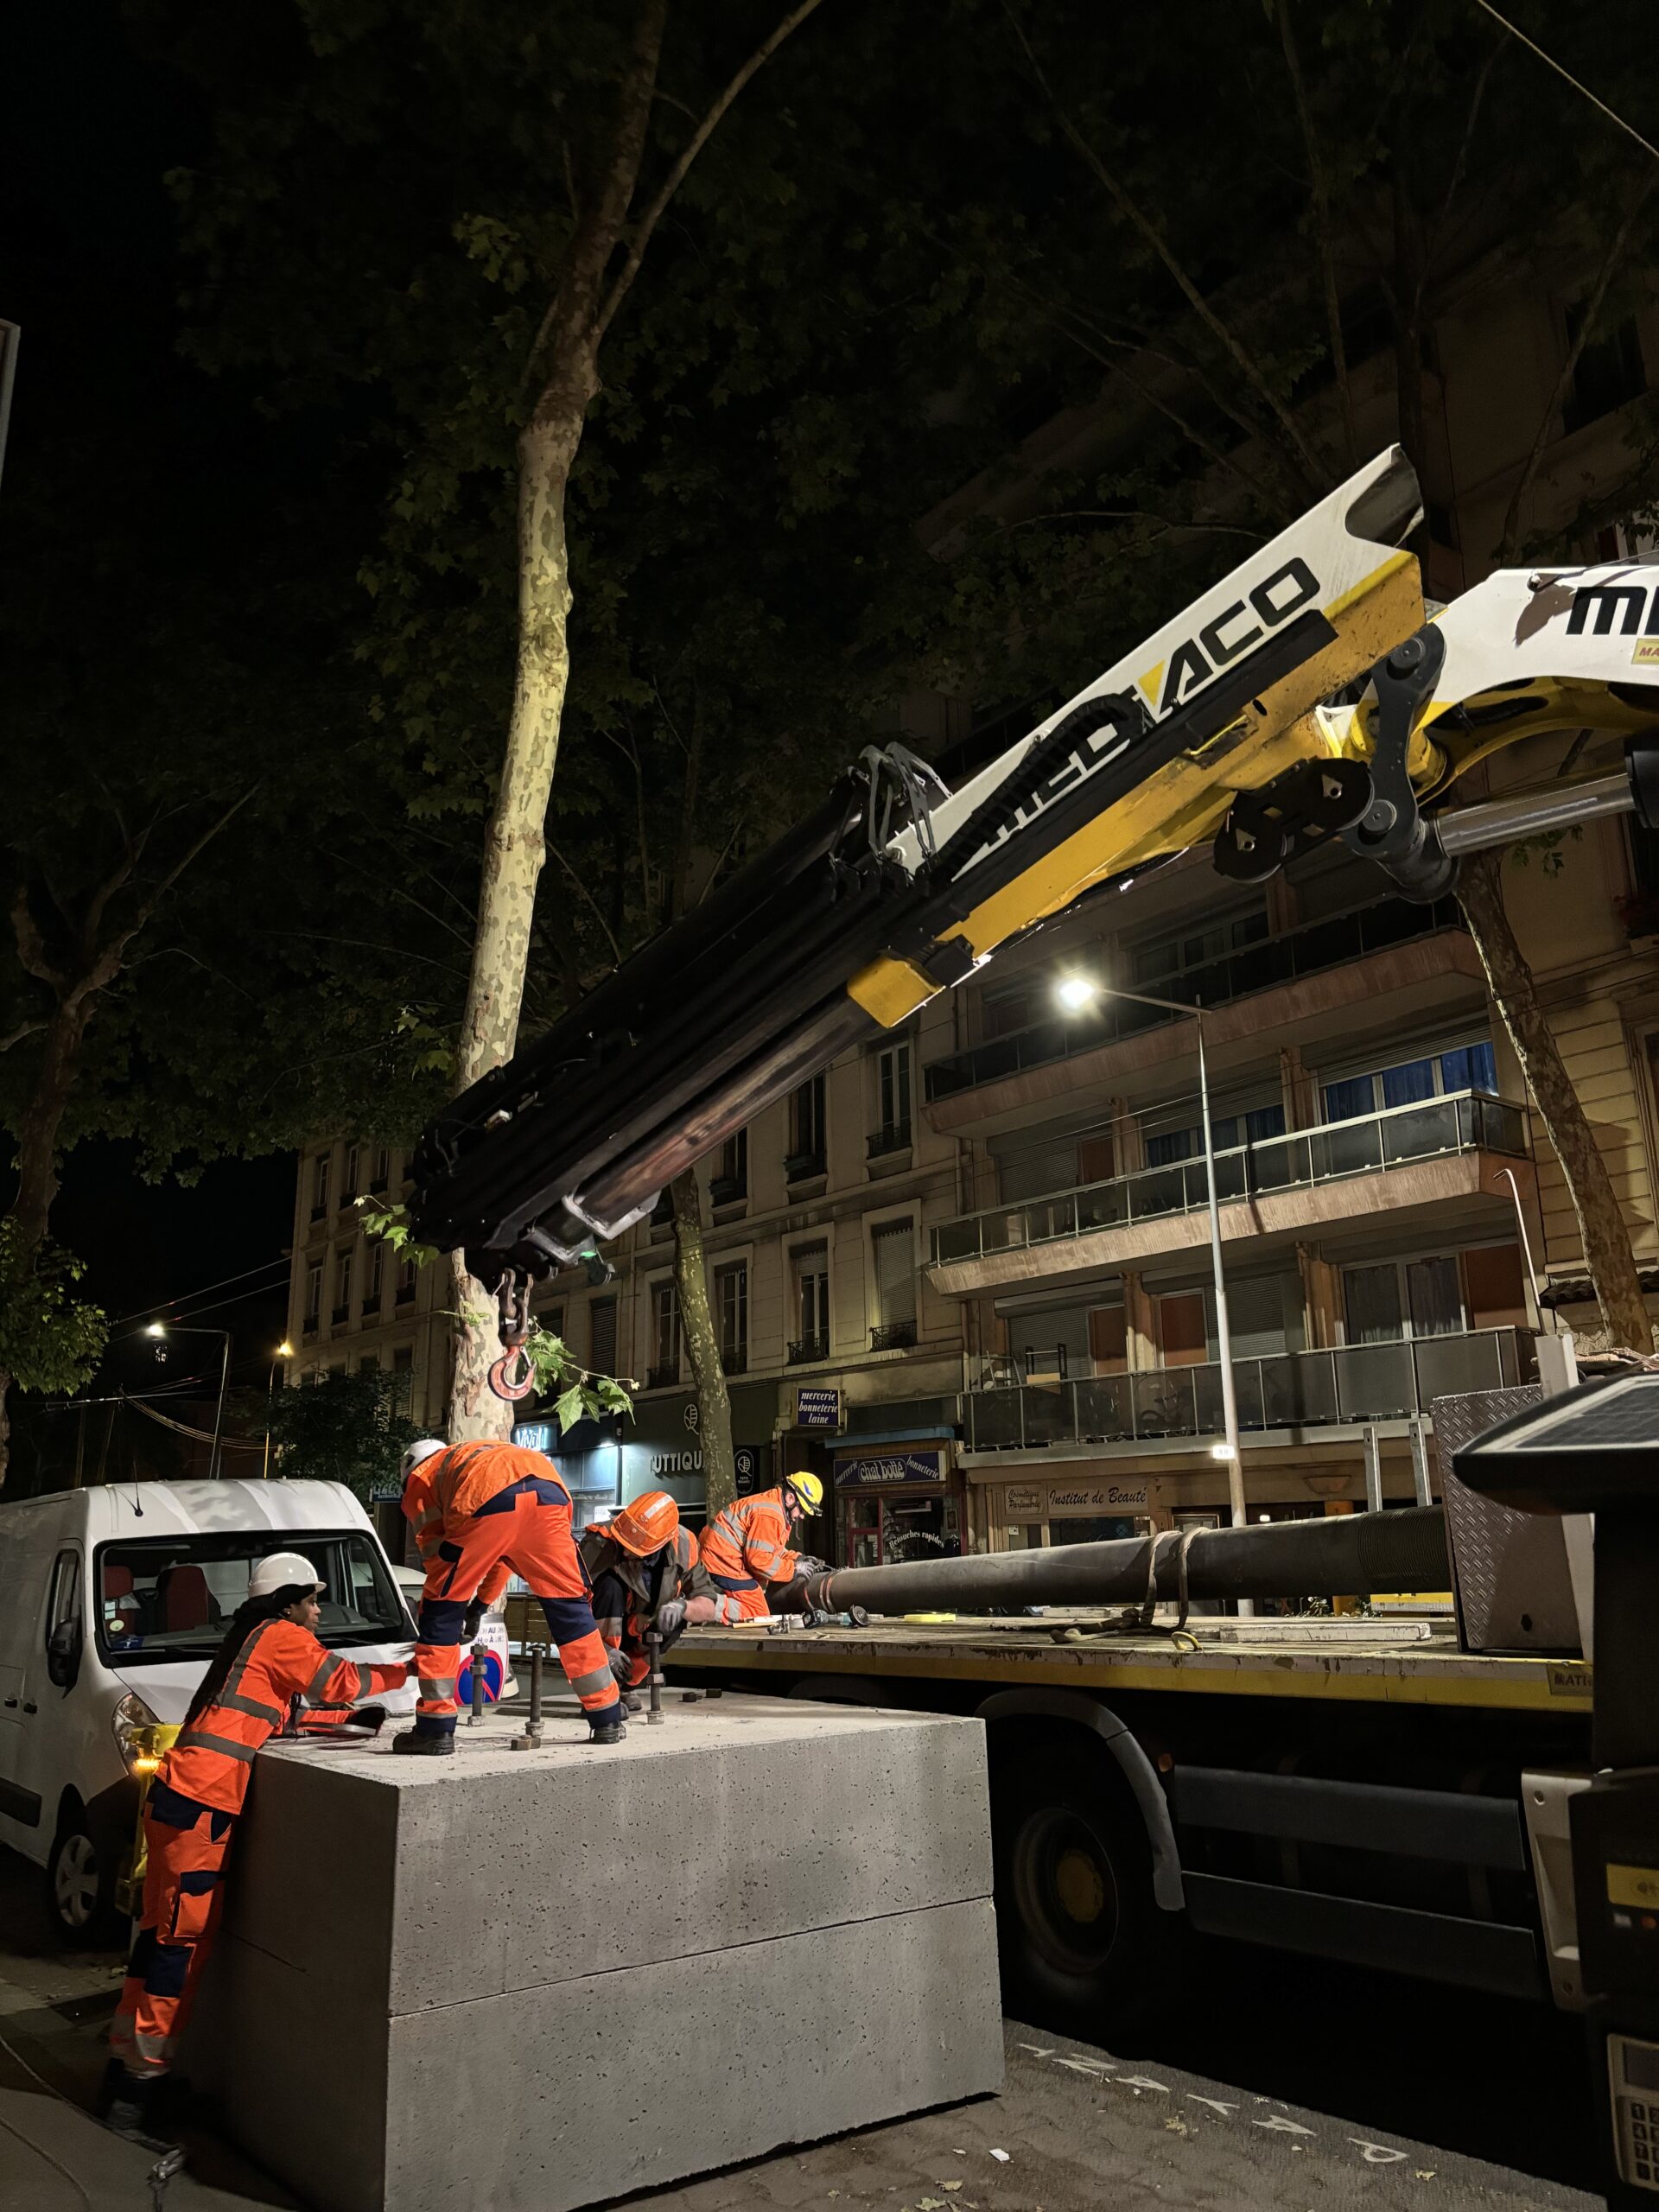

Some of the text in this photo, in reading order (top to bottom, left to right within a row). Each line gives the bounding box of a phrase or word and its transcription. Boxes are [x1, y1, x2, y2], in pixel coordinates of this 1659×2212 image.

[801, 1390, 836, 1402] mercerie
[798, 1402, 837, 1413] bonneterie
[808, 1413, 829, 1424] laine
[650, 1450, 705, 1473] UTTIQU
[860, 1460, 905, 1481] chat botté
[907, 1455, 939, 1479] bonneterie
[836, 1459, 858, 1486] mercerie
[1049, 1487, 1147, 1505] Institut de Beauté
[888, 1529, 945, 1549] Retouches rapides
